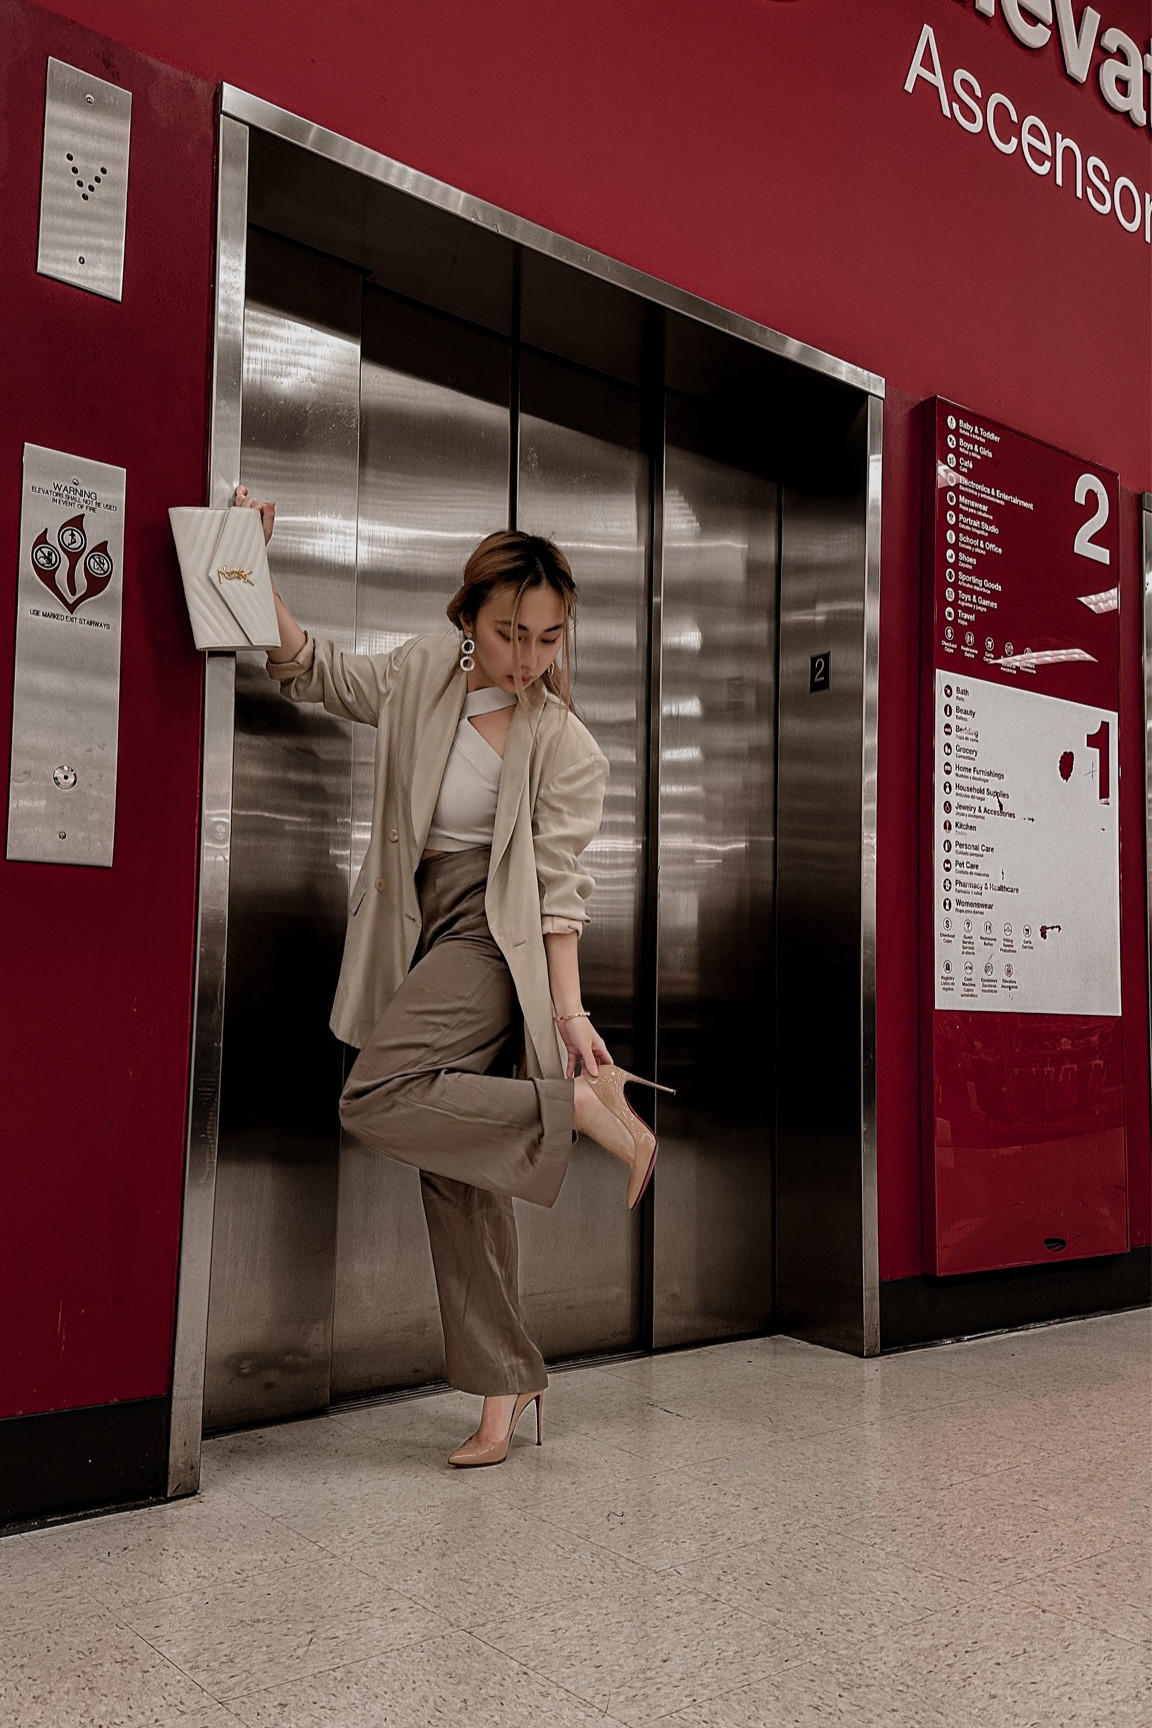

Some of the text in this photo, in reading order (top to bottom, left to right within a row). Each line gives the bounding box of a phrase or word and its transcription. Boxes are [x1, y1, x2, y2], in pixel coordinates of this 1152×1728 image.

[975, 0, 1152, 128] eva
[959, 419, 974, 432] Baby
[974, 425, 979, 434] &
[980, 427, 1000, 443] Toddler
[959, 438, 992, 458] Boys & Girls
[959, 457, 973, 469] Café
[31, 486, 63, 498] ELEVATORS
[65, 493, 81, 503] SHALL
[103, 503, 117, 512] USED
[53, 482, 97, 501] WARNING
[959, 477, 990, 494] Electronics
[991, 488, 996, 496] &
[996, 490, 1034, 510] Entertainment
[59, 499, 75, 507] EVENT
[959, 494, 989, 512] Menswear
[959, 513, 980, 528] Portrait
[981, 521, 999, 535] Studio
[1074, 473, 1110, 566] 2
[959, 533, 1002, 554] School & Office
[958, 552, 977, 565] Shoes
[958, 571, 1002, 592] Sporting Goods
[958, 590, 997, 609] Toys & Games
[30, 609, 110, 630] USE MARKED EXIT STAIRWAYS
[958, 609, 975, 621] Travel
[814, 658, 825, 682] 2
[956, 686, 969, 697] Bath
[956, 705, 976, 719] Beauty
[956, 744, 978, 757] Grocery
[1087, 720, 1110, 805] 1
[955, 763, 972, 774] Home
[973, 767, 1004, 780] Furnishings
[955, 783, 1009, 800] Household Supplies
[955, 803, 976, 813] Jewelry
[983, 806, 1015, 819] Accessories
[955, 821, 977, 832] Kitchen
[955, 840, 994, 853] Personal Care
[955, 860, 979, 870] Pet Care
[955, 879, 983, 891] Pharmacy
[990, 883, 1019, 894] Healthcare
[956, 899, 994, 910] Womenswear
